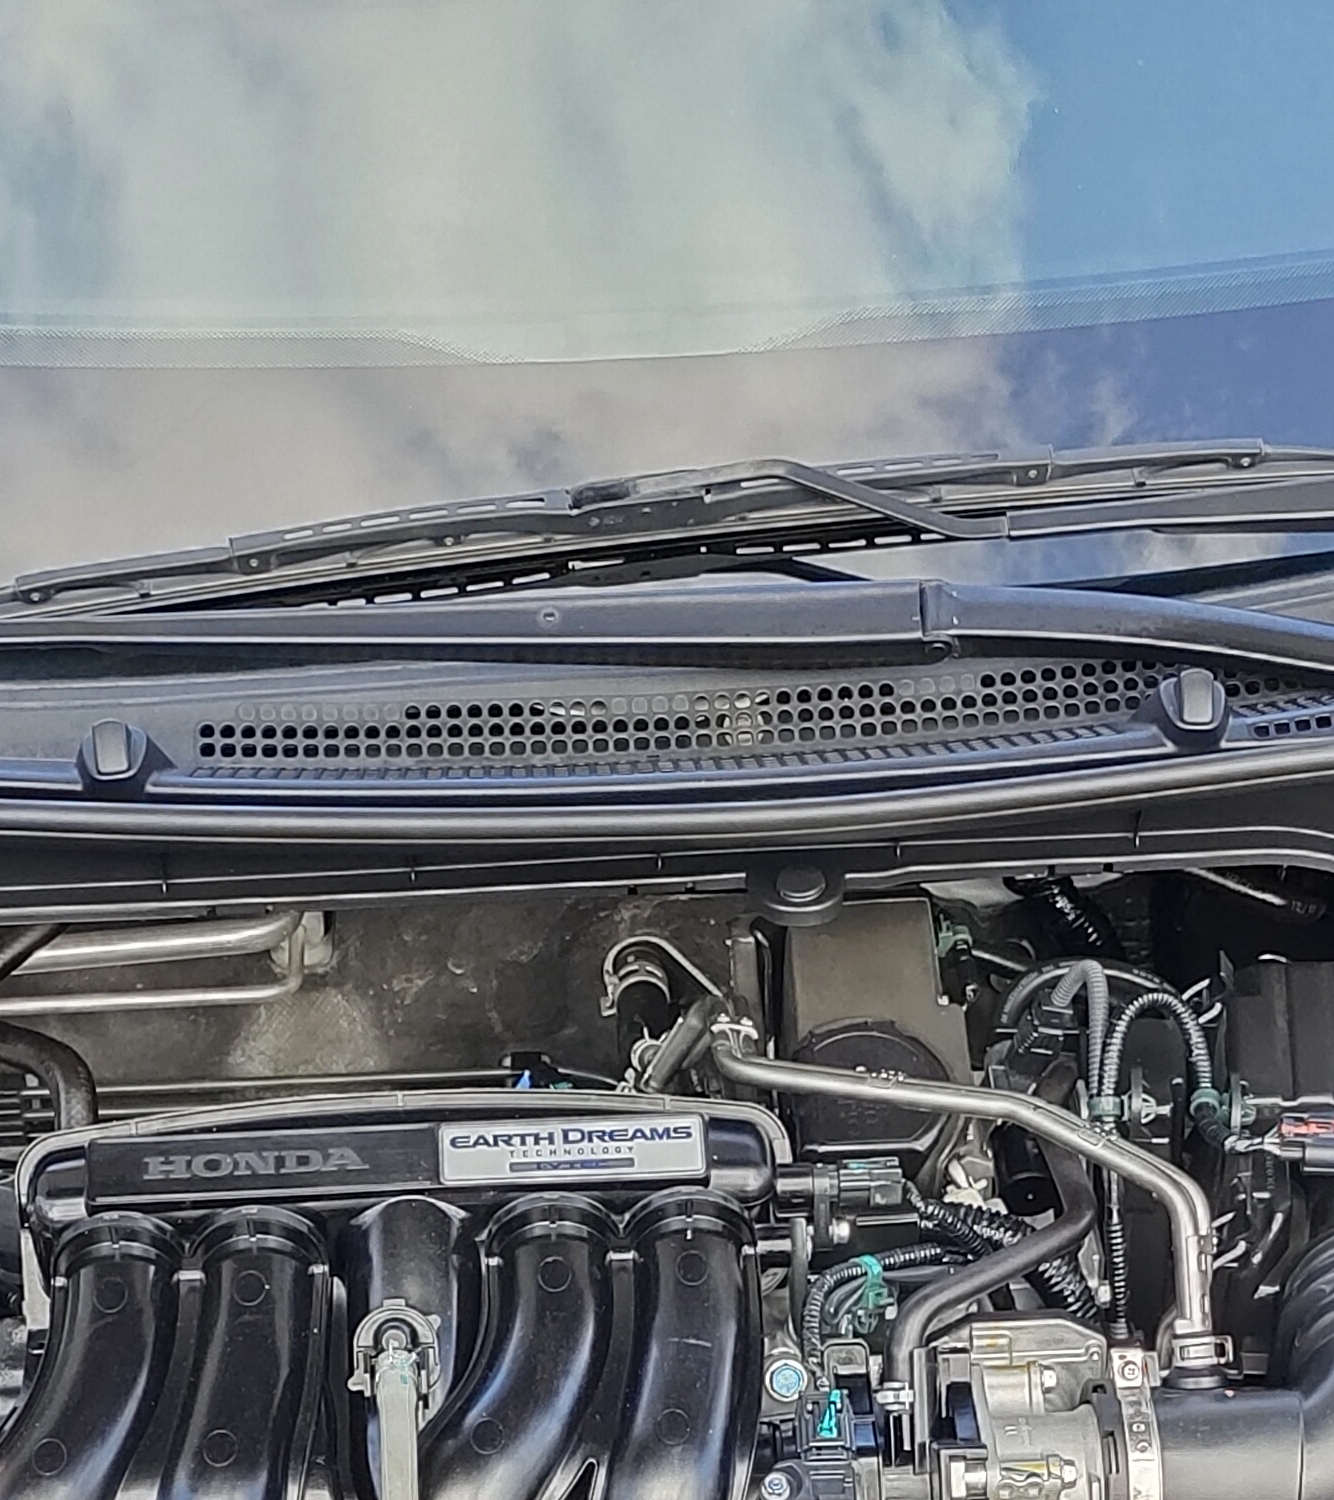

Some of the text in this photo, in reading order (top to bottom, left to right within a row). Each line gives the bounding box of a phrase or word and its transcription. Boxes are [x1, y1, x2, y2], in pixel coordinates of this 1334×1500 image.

[449, 1126, 693, 1149] EARTH DREAMS
[143, 1147, 370, 1180] HONDA
[509, 1145, 635, 1159] TECHNOLOGY
